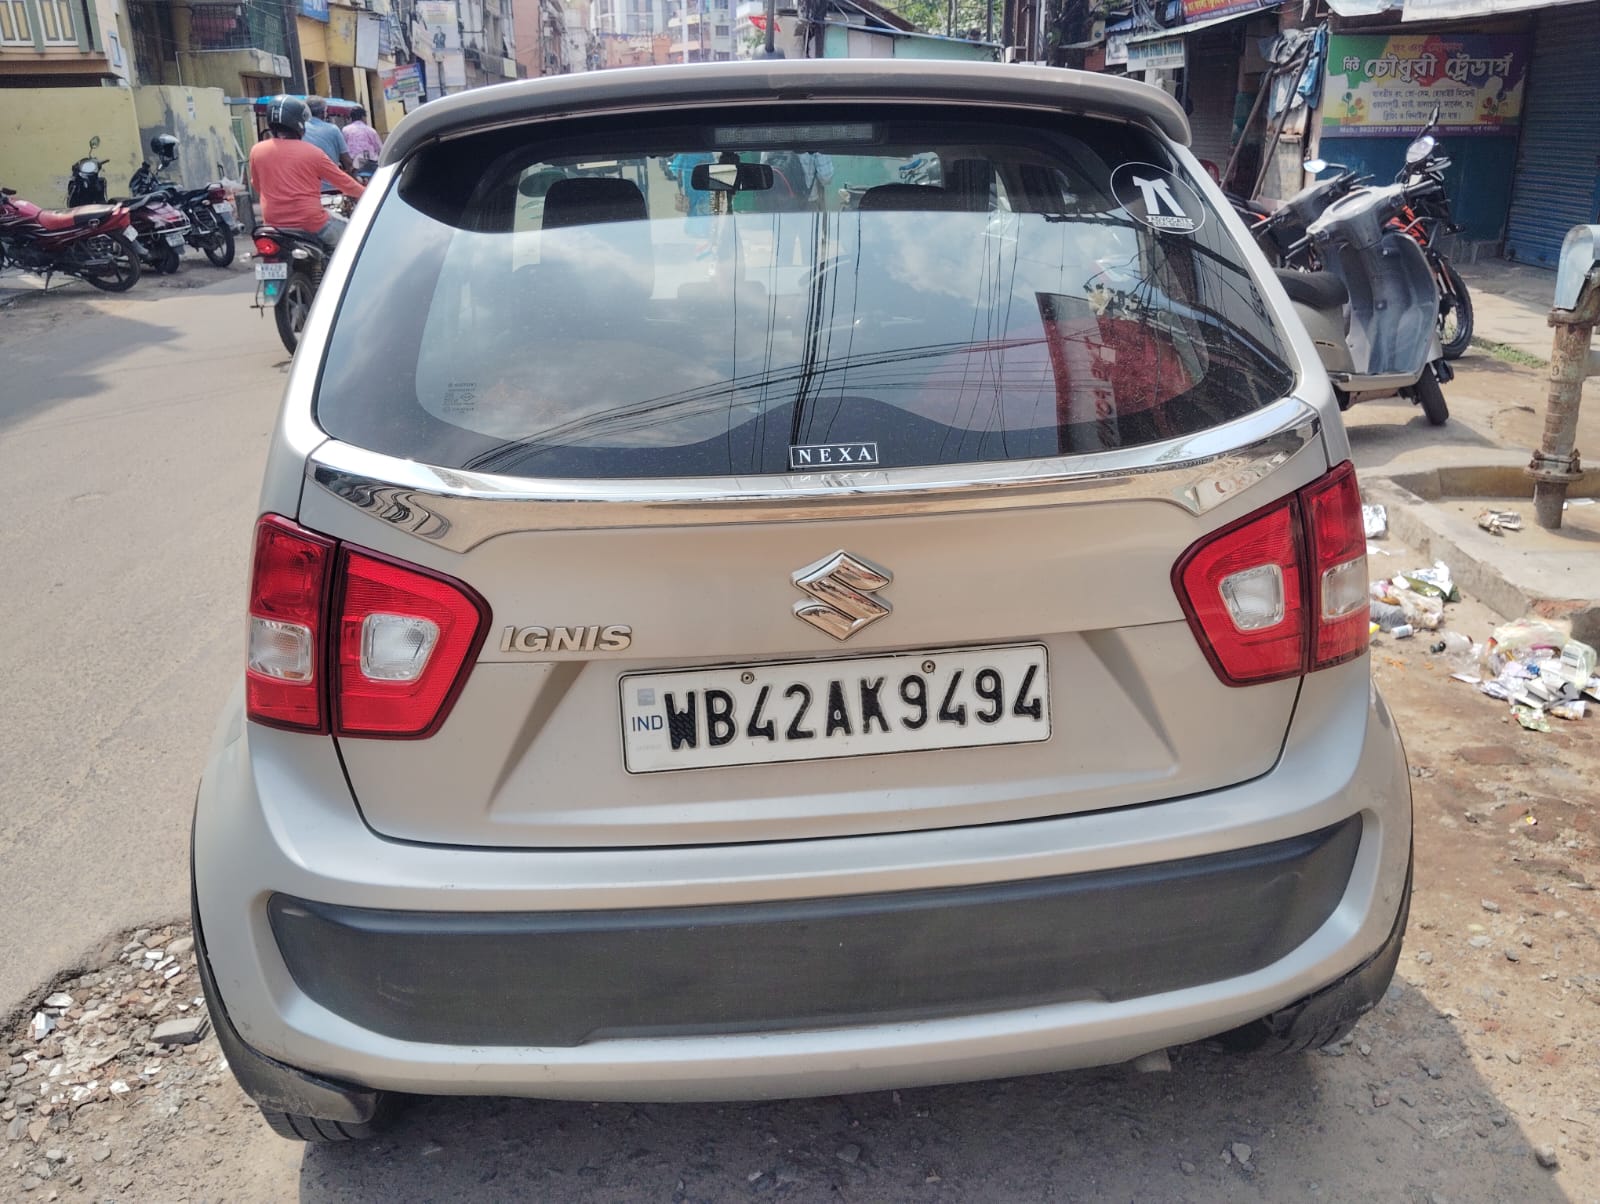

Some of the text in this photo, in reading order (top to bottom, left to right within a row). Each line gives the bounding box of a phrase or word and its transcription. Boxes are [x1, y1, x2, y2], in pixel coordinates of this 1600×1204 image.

[1342, 52, 1515, 82] নিউ চৌধুরী ট্রেডার্স
[798, 446, 873, 464] NEXA
[500, 624, 633, 653] IGNIS
[632, 664, 1042, 751] IND WB42AK9494
